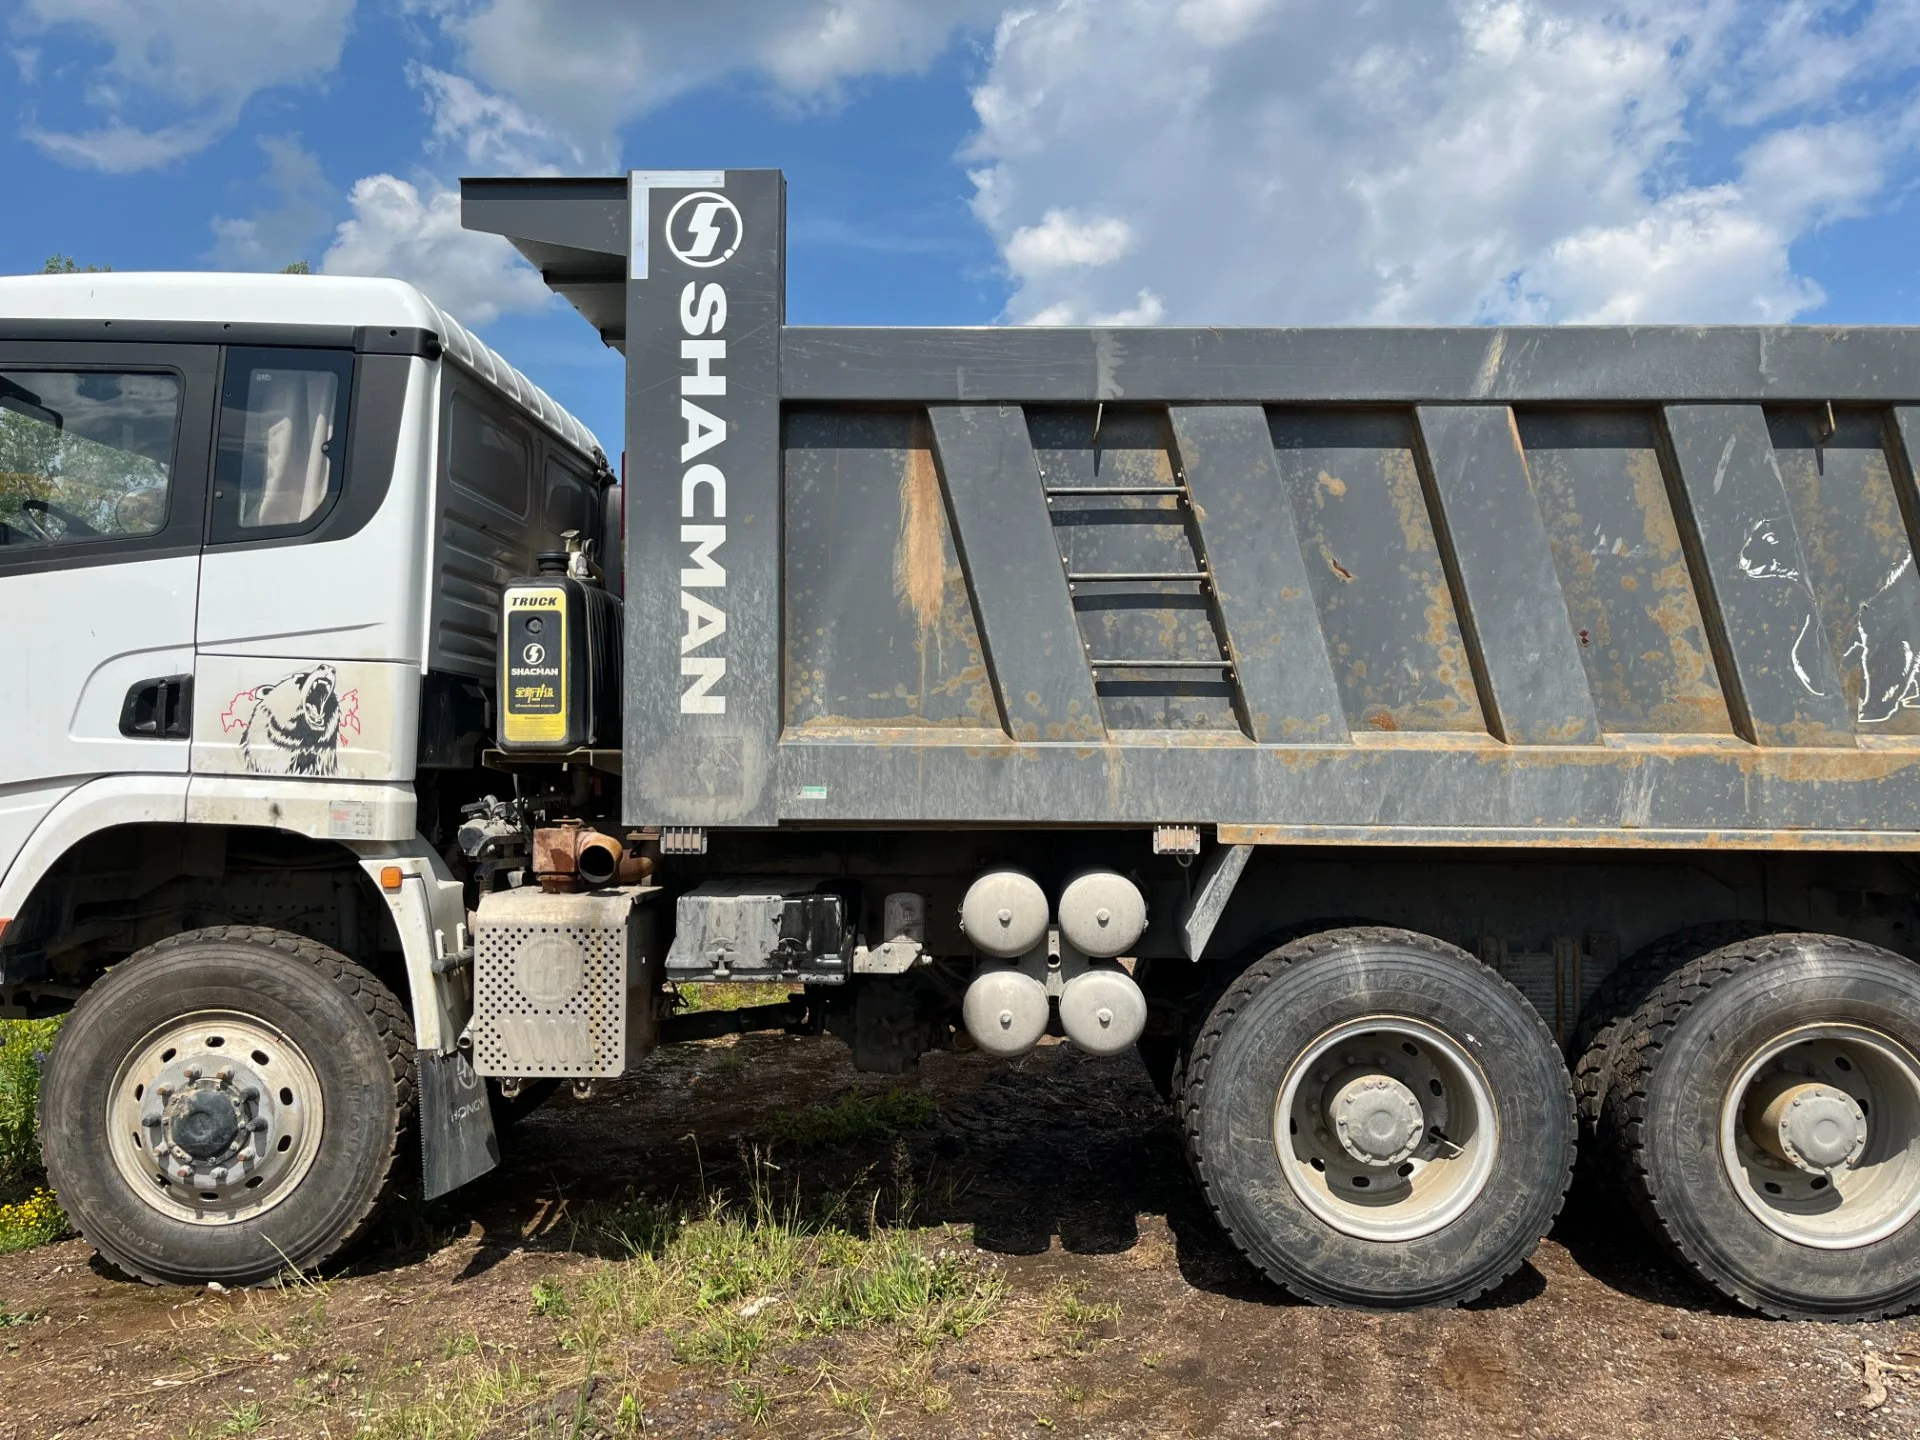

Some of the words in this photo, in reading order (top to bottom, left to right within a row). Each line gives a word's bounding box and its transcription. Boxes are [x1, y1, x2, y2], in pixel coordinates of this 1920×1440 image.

[681, 281, 726, 714] SHACMAN
[511, 597, 558, 606] TRUCK
[511, 667, 559, 676] SHACMAN
